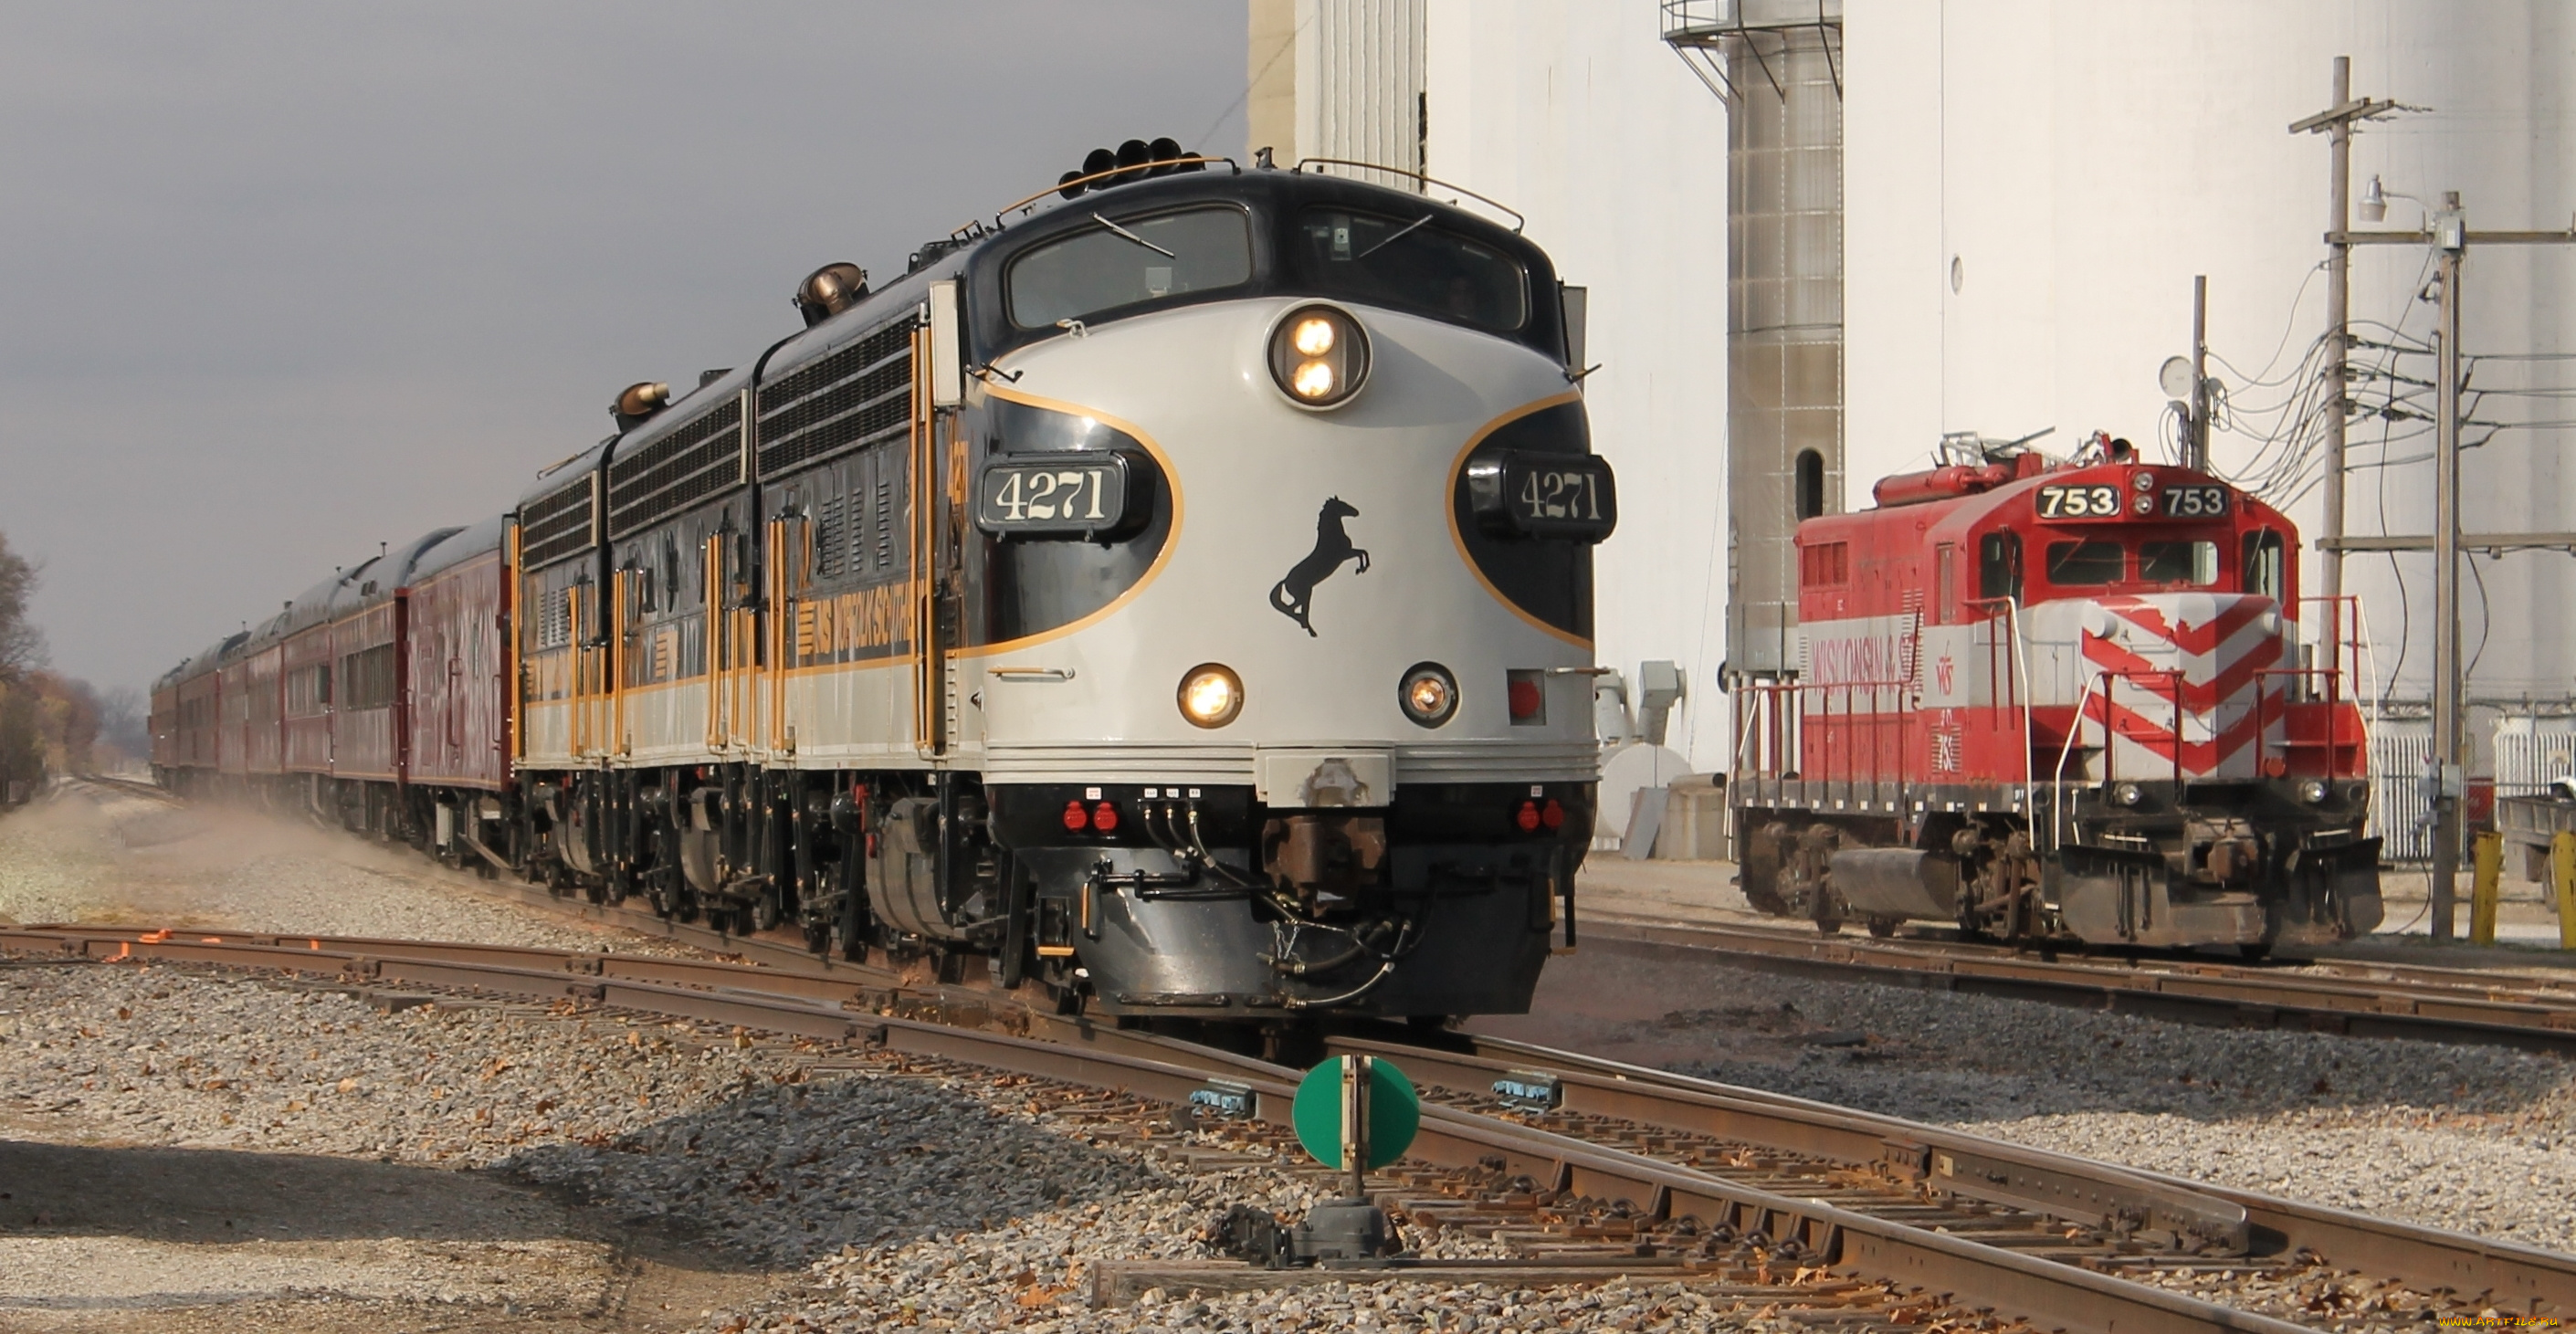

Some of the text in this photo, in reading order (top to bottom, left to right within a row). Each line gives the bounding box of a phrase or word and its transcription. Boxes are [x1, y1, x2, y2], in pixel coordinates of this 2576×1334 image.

[994, 470, 1106, 520] 4271
[1521, 470, 1602, 520] 4271
[2042, 487, 2115, 516] 753
[2165, 488, 2224, 516] 753
[1813, 636, 1883, 696] WISCONSIN
